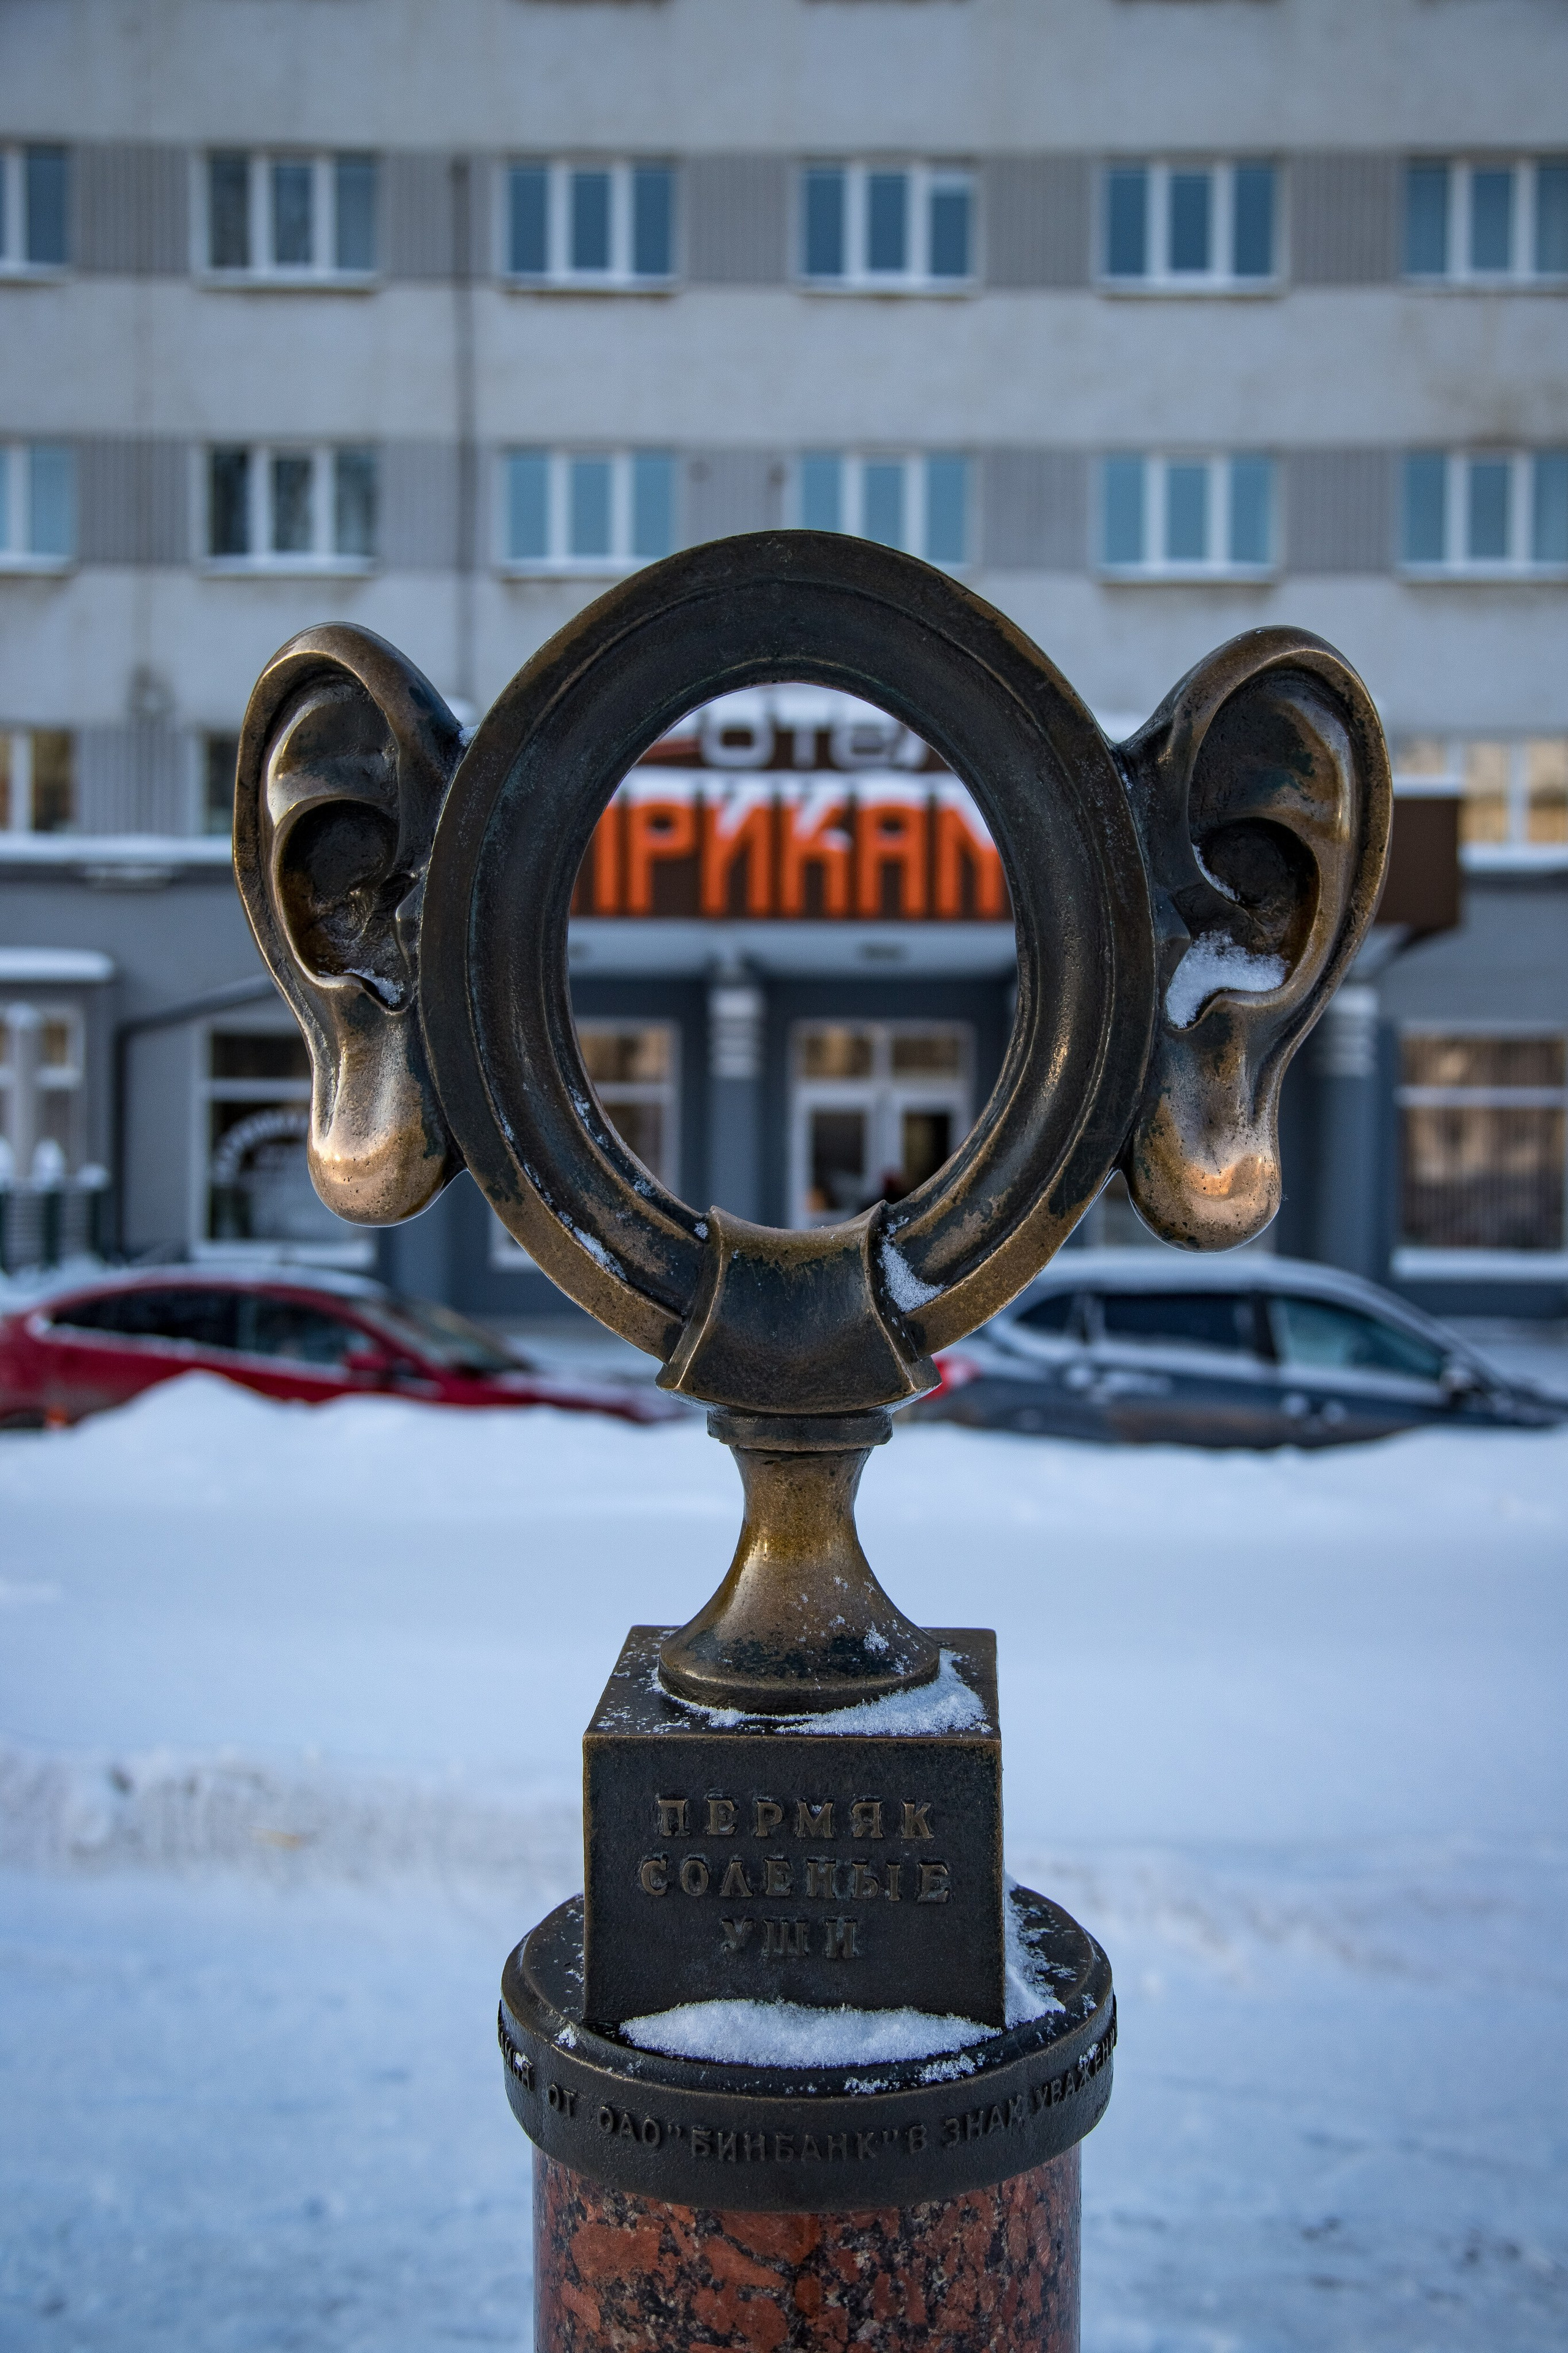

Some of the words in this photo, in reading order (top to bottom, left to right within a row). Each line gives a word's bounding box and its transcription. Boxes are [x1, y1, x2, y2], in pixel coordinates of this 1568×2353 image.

[657, 1796, 935, 1839] ПЕРМЯК
[640, 1856, 951, 1903] СОЛЕНЫЕ
[721, 1917, 858, 1960] УШИ
[548, 2084, 576, 2118] ОТ
[597, 2104, 661, 2147] ОАО
[943, 2093, 1026, 2147] ЗНАК
